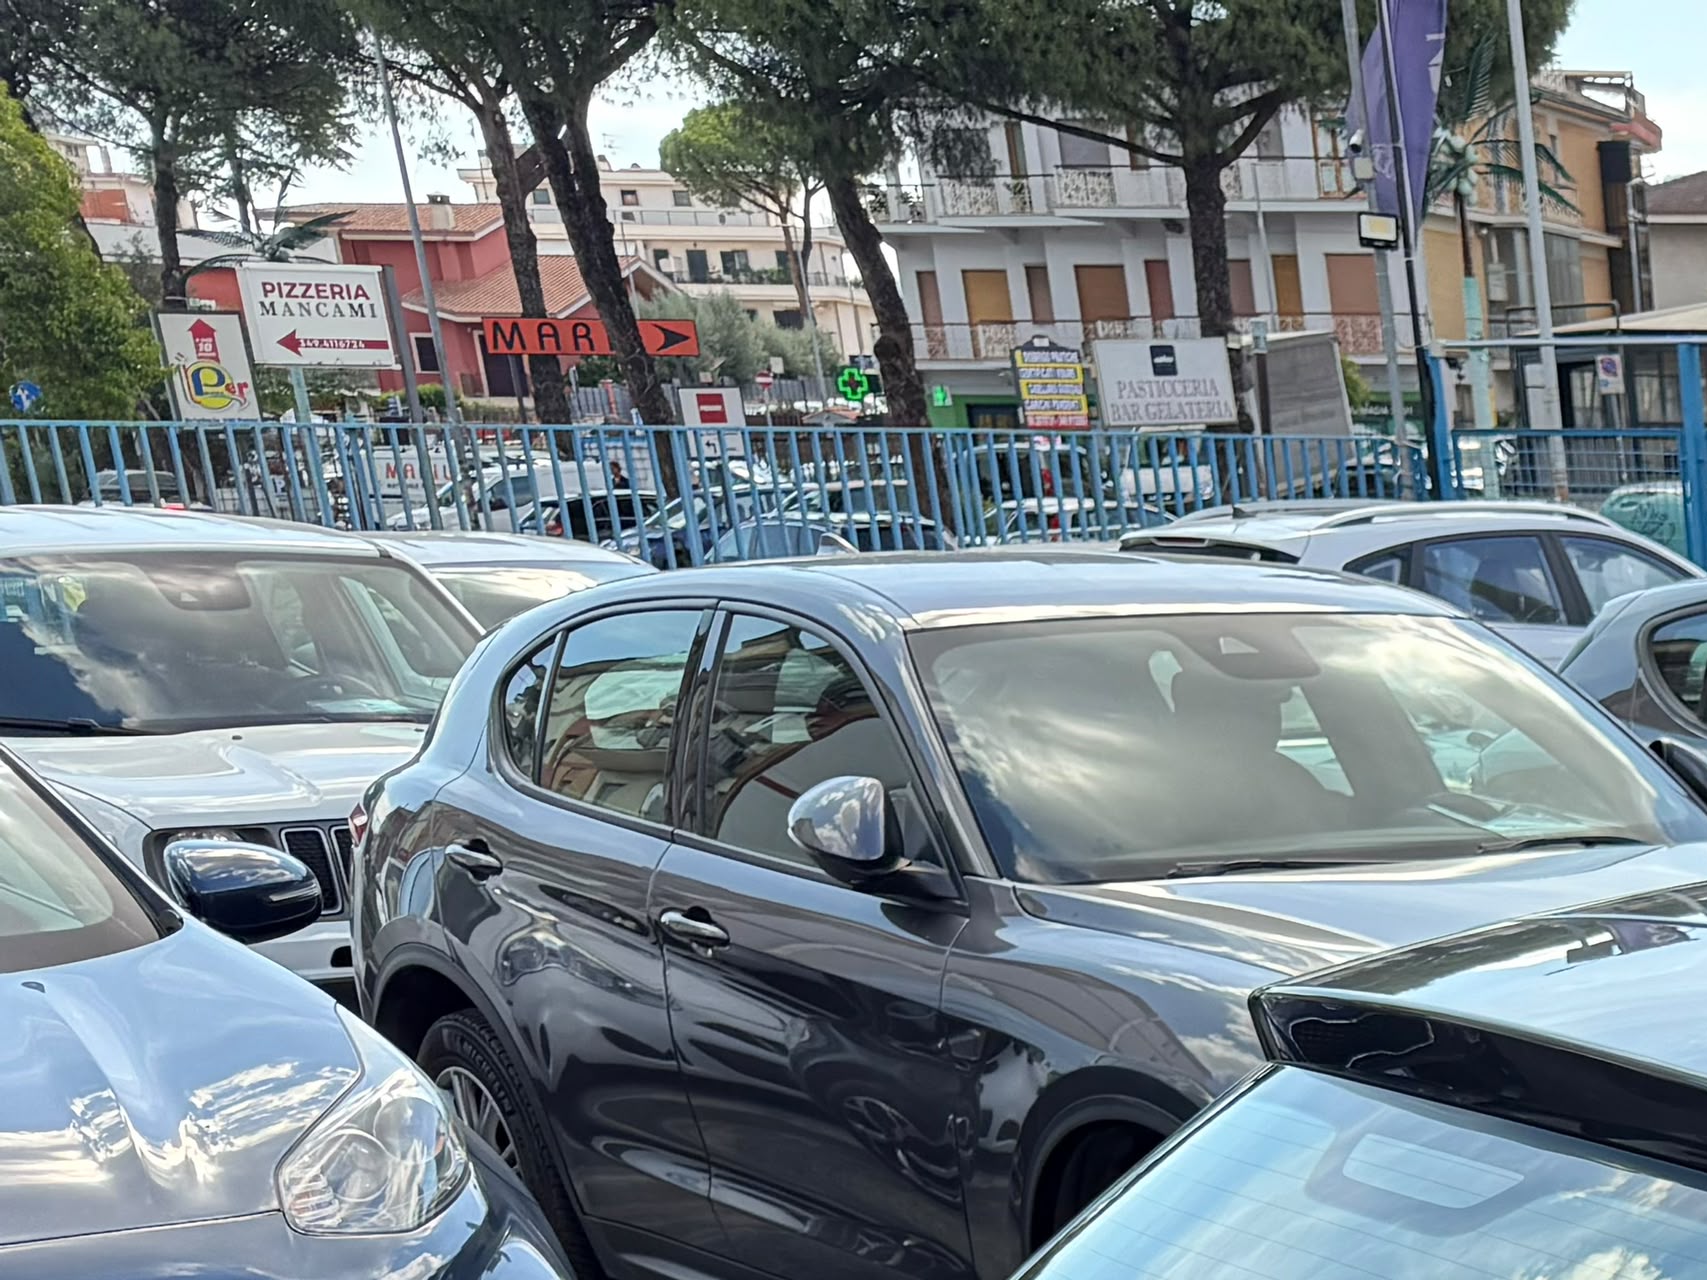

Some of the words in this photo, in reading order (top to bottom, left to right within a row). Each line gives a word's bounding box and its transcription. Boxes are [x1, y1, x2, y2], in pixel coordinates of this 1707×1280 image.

[261, 281, 370, 300] PIZZERIA
[258, 301, 378, 318] MANCAMI
[492, 320, 616, 352] MAR
[1116, 379, 1219, 399] PASTICCERIA
[1110, 402, 1146, 422] BAR
[1148, 400, 1235, 421] GELATERIA
